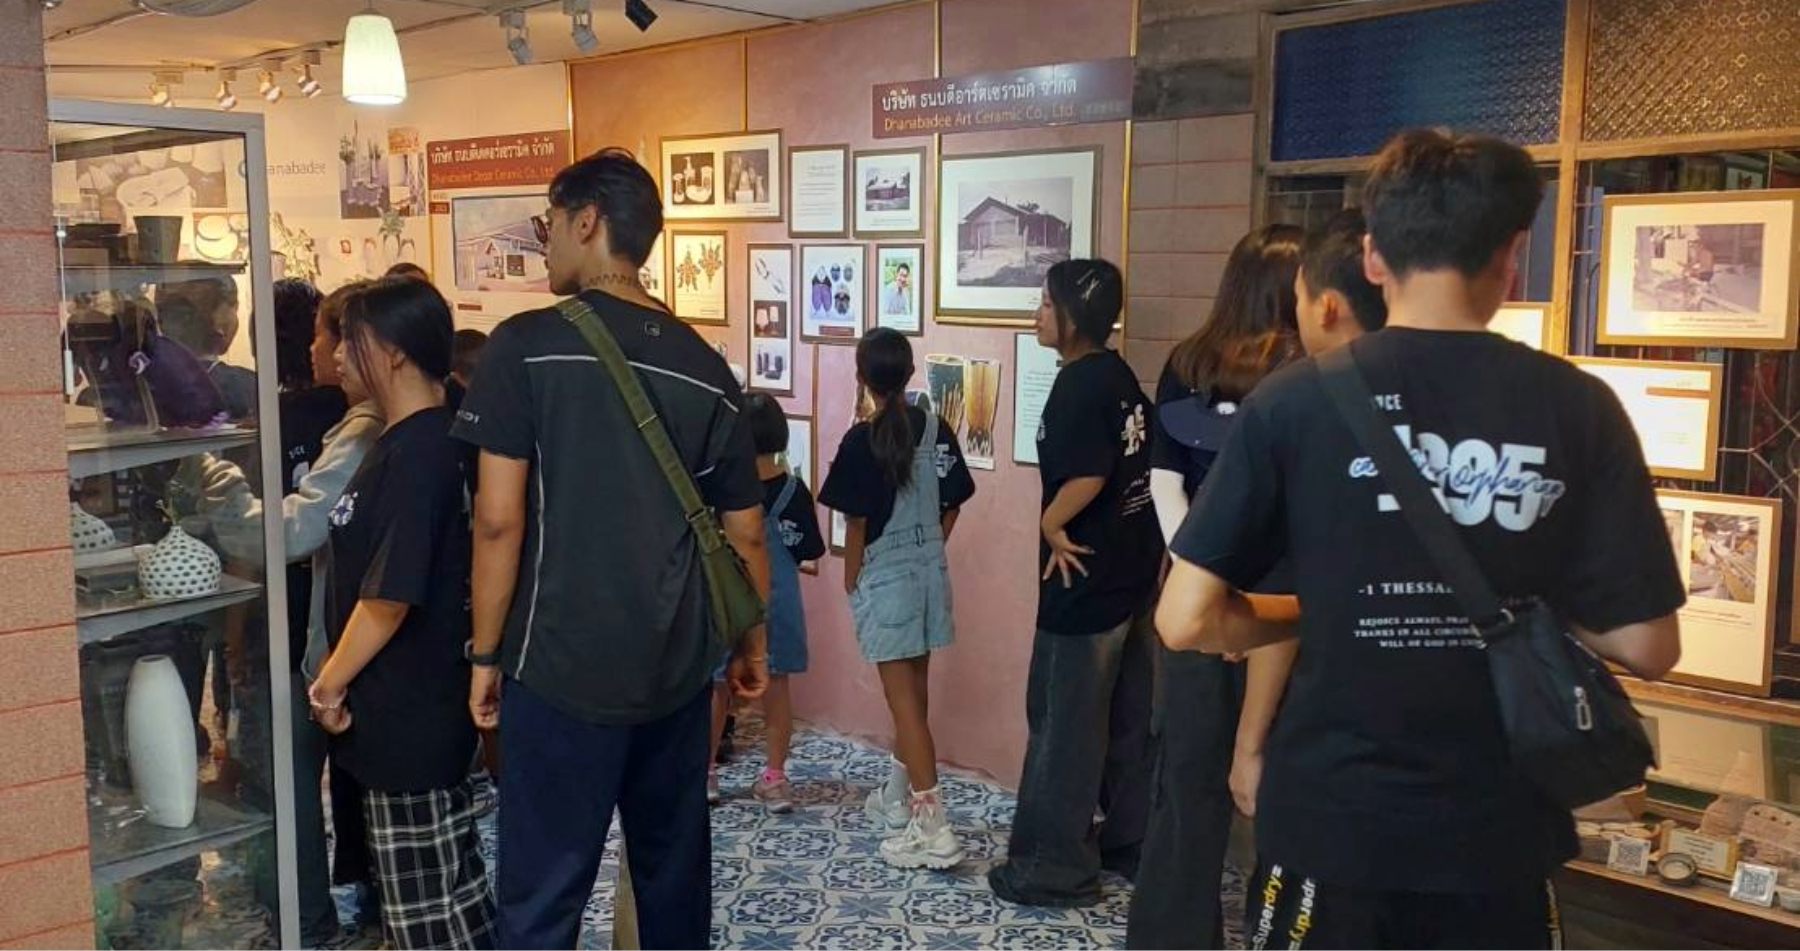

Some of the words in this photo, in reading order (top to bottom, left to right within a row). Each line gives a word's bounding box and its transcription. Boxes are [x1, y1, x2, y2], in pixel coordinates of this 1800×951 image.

[881, 88, 917, 111] บริษัท
[884, 113, 953, 131] Dhanabadee
[955, 111, 972, 126] Art
[975, 108, 1022, 124] Ceramic
